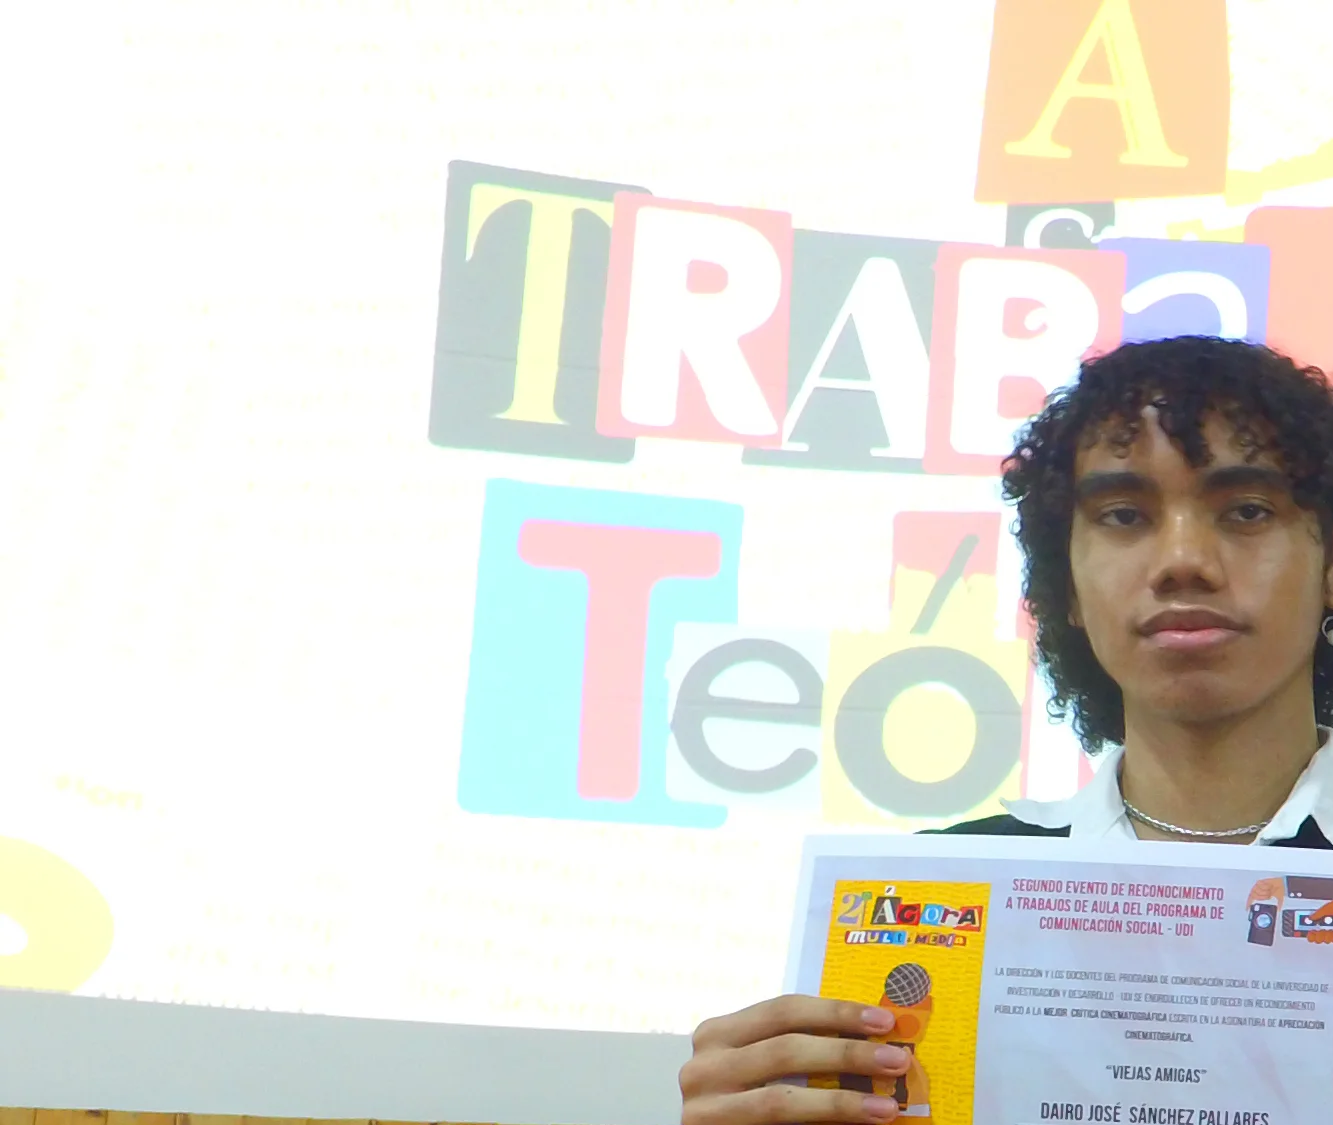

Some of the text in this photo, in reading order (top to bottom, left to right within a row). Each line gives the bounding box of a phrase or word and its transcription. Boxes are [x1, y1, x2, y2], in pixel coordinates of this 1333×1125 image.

[1003, 0, 1188, 168] A
[1012, 878, 1224, 901] SEGUNDO EVENTO DE RECONOCIMIENTO
[1005, 897, 1224, 919] A TRABAJOS DE AULA DEL PROGRAMA DE
[1039, 916, 1194, 937] COMUNICACIÓN SOCIAL UDI
[1040, 1102, 1084, 1121] DAIRO
[1087, 1101, 1122, 1123] JOSÉ
[1129, 1103, 1195, 1125] SÁNCHEZ
